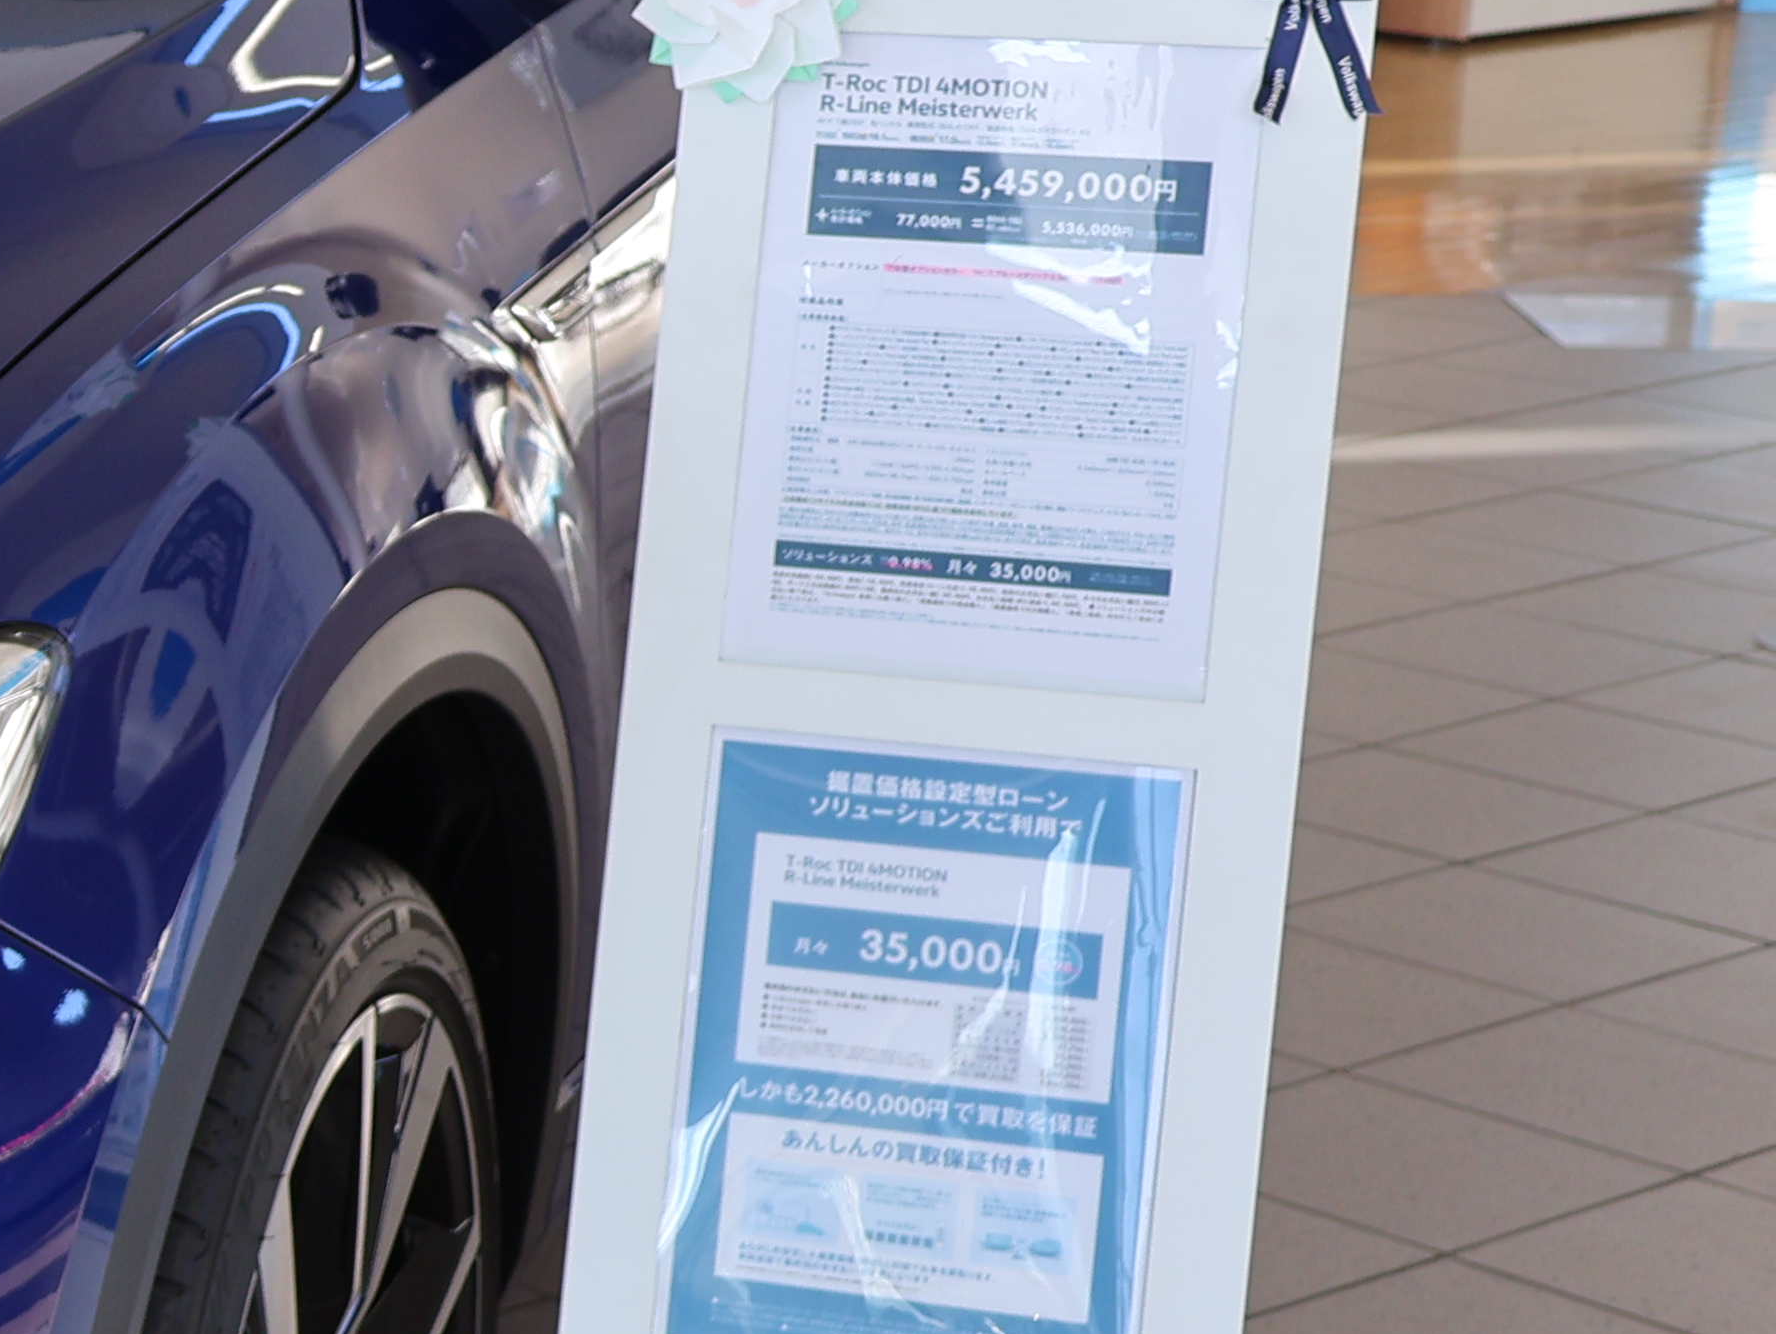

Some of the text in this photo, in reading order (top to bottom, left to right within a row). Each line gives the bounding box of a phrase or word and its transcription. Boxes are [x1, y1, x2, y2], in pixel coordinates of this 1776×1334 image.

[822, 72, 1048, 99] T-Roc TDI 4MOTION
[820, 97, 1038, 120] R-Line Meisterwerk
[834, 165, 1178, 203] 車両本体価格 5,459,000円
[896, 212, 962, 231] 77,000円
[781, 548, 873, 567] ソリューションズ
[946, 558, 978, 576] 月々
[989, 561, 1072, 583] 35,000円
[809, 795, 1083, 840] ソリューションズご利用で
[785, 854, 948, 882] T-Roc TDI 4MOTION
[784, 870, 939, 898] R-Line Meisterwerk
[793, 936, 829, 955] 月々
